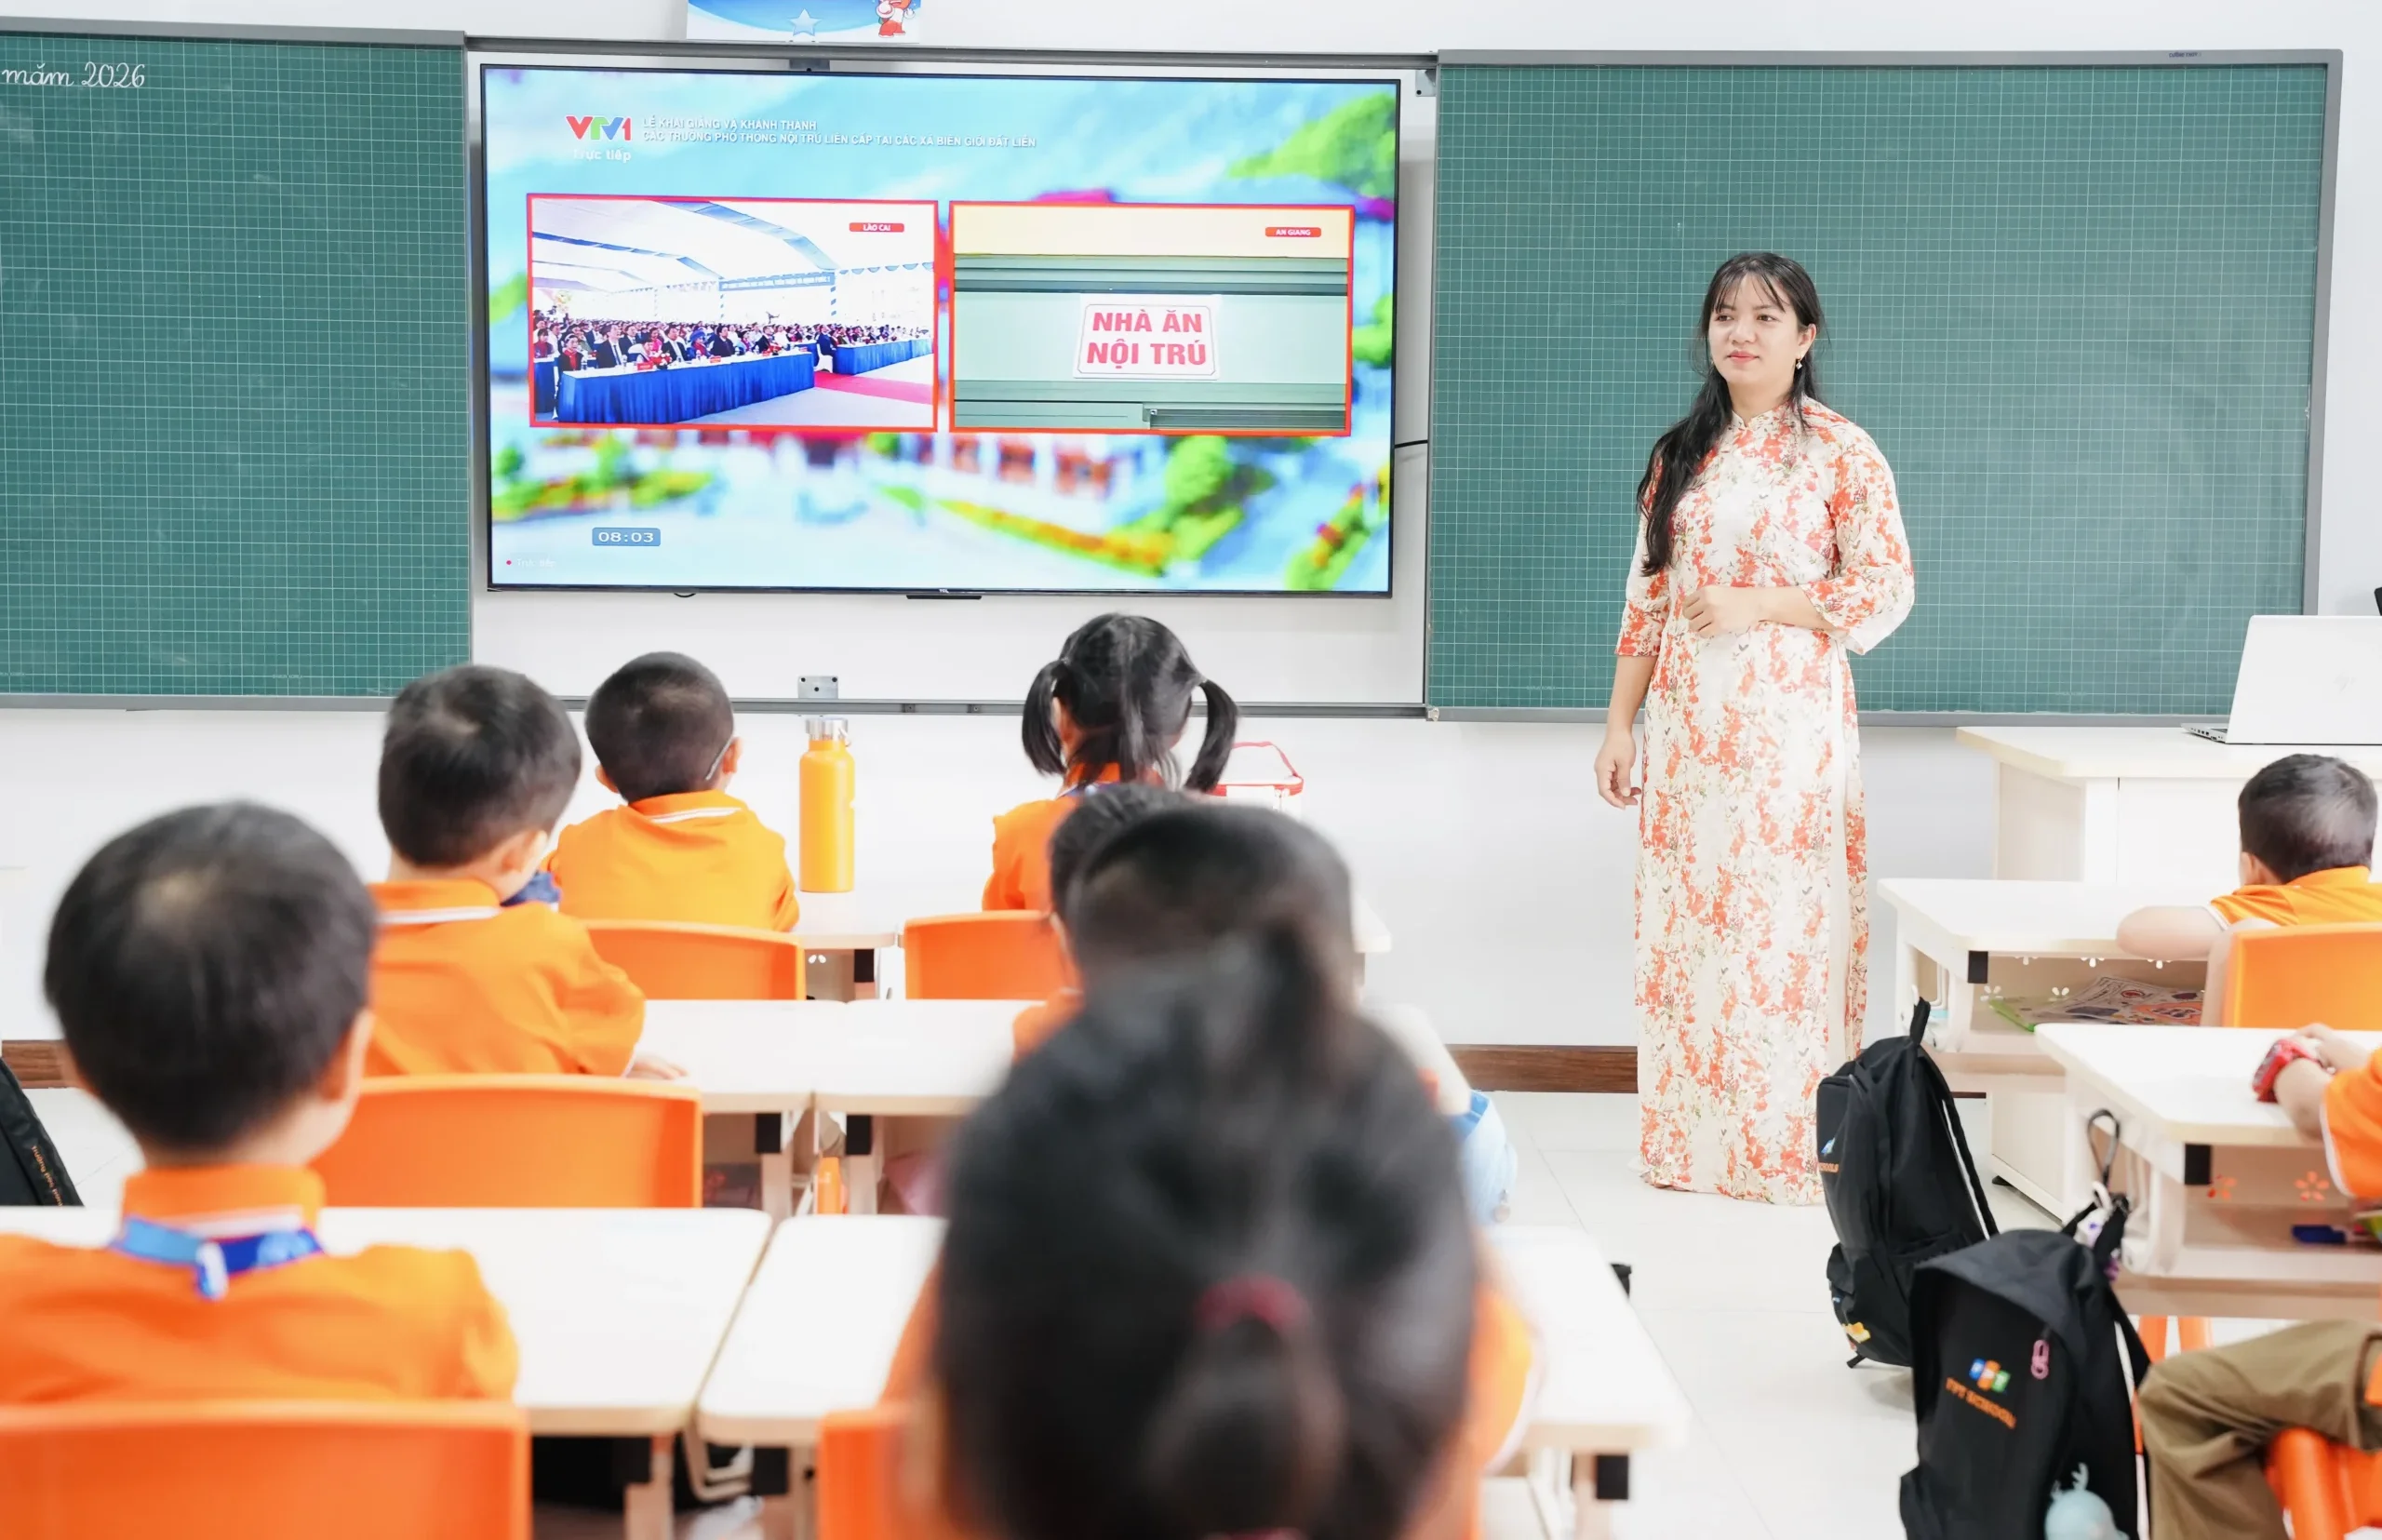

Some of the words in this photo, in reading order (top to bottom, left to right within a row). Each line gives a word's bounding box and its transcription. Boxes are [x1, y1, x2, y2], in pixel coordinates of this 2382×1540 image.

[81, 60, 145, 88] 2026
[565, 115, 632, 141] VTV1
[659, 117, 685, 129] KHAI
[1092, 309, 1153, 332] NHÀ
[1162, 309, 1203, 333] ĂN
[1087, 338, 1139, 368] NỘI
[1150, 340, 1207, 366] TRÚ
[598, 531, 654, 542] 08:03
